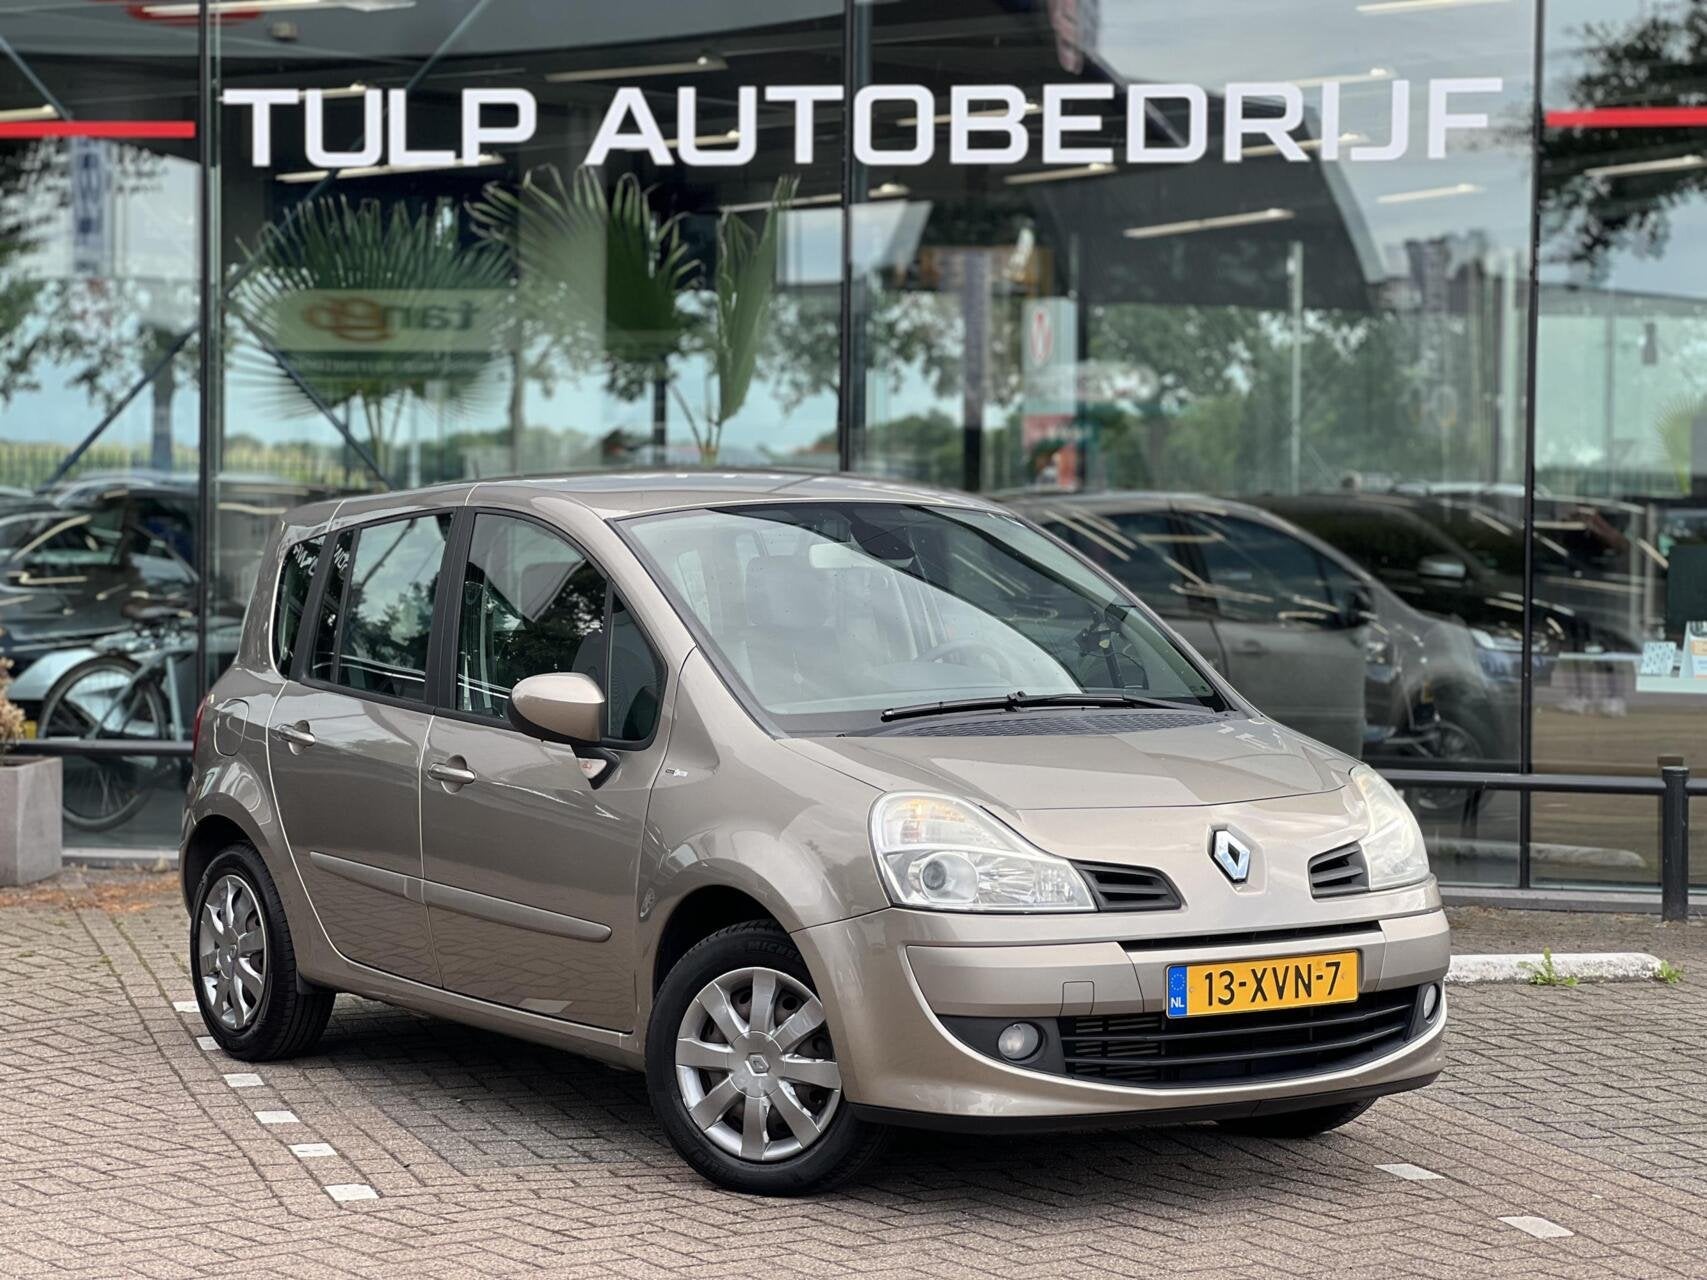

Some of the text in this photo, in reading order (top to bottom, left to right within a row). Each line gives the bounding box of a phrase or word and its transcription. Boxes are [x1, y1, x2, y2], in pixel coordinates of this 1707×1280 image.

[222, 77, 1504, 167] TULP AUTOBEDRIJF
[1169, 996, 1185, 1009] NL
[1204, 960, 1342, 1008] 13-XVN-7
